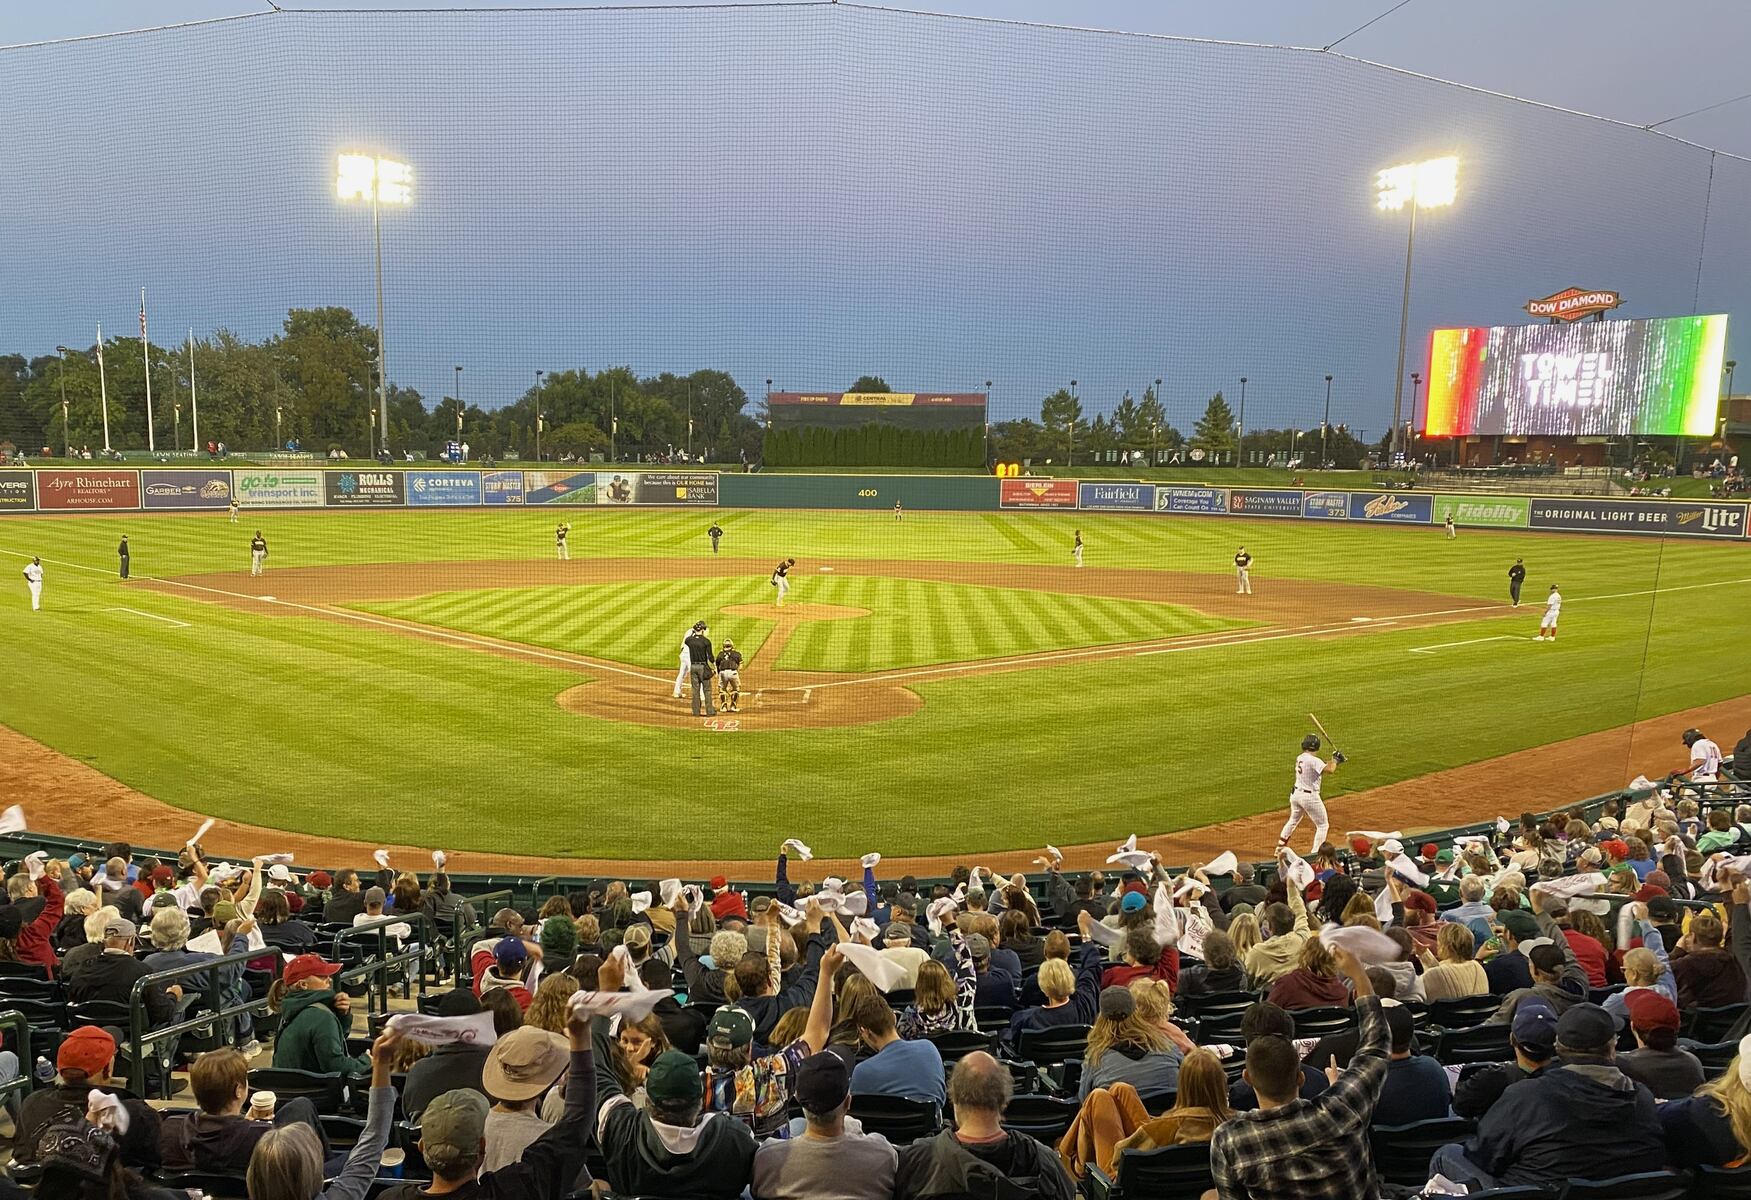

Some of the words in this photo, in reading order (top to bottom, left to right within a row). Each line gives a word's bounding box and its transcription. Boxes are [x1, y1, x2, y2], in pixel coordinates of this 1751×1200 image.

[1530, 302, 1557, 313] DOW
[1559, 293, 1614, 311] DIAMOND
[1521, 353, 1613, 381] TOWEL
[47, 477, 74, 492] Ayre
[76, 477, 131, 488] Rhinehart
[359, 473, 394, 486] ROLLS
[428, 479, 475, 487] CORTEVA
[146, 486, 182, 496] GARBER
[249, 488, 298, 498] transport
[300, 487, 318, 497] inc.
[858, 489, 878, 497] 400
[1094, 488, 1139, 500] Fairfield
[1327, 508, 1346, 517] 373
[1456, 503, 1523, 522] Fidelity
[1545, 509, 1596, 520] ORIGINAL
[1601, 511, 1633, 521] LIGHT
[1638, 512, 1668, 522] BEER
[1675, 511, 1704, 525] Miller
[1701, 507, 1741, 531] Lite
